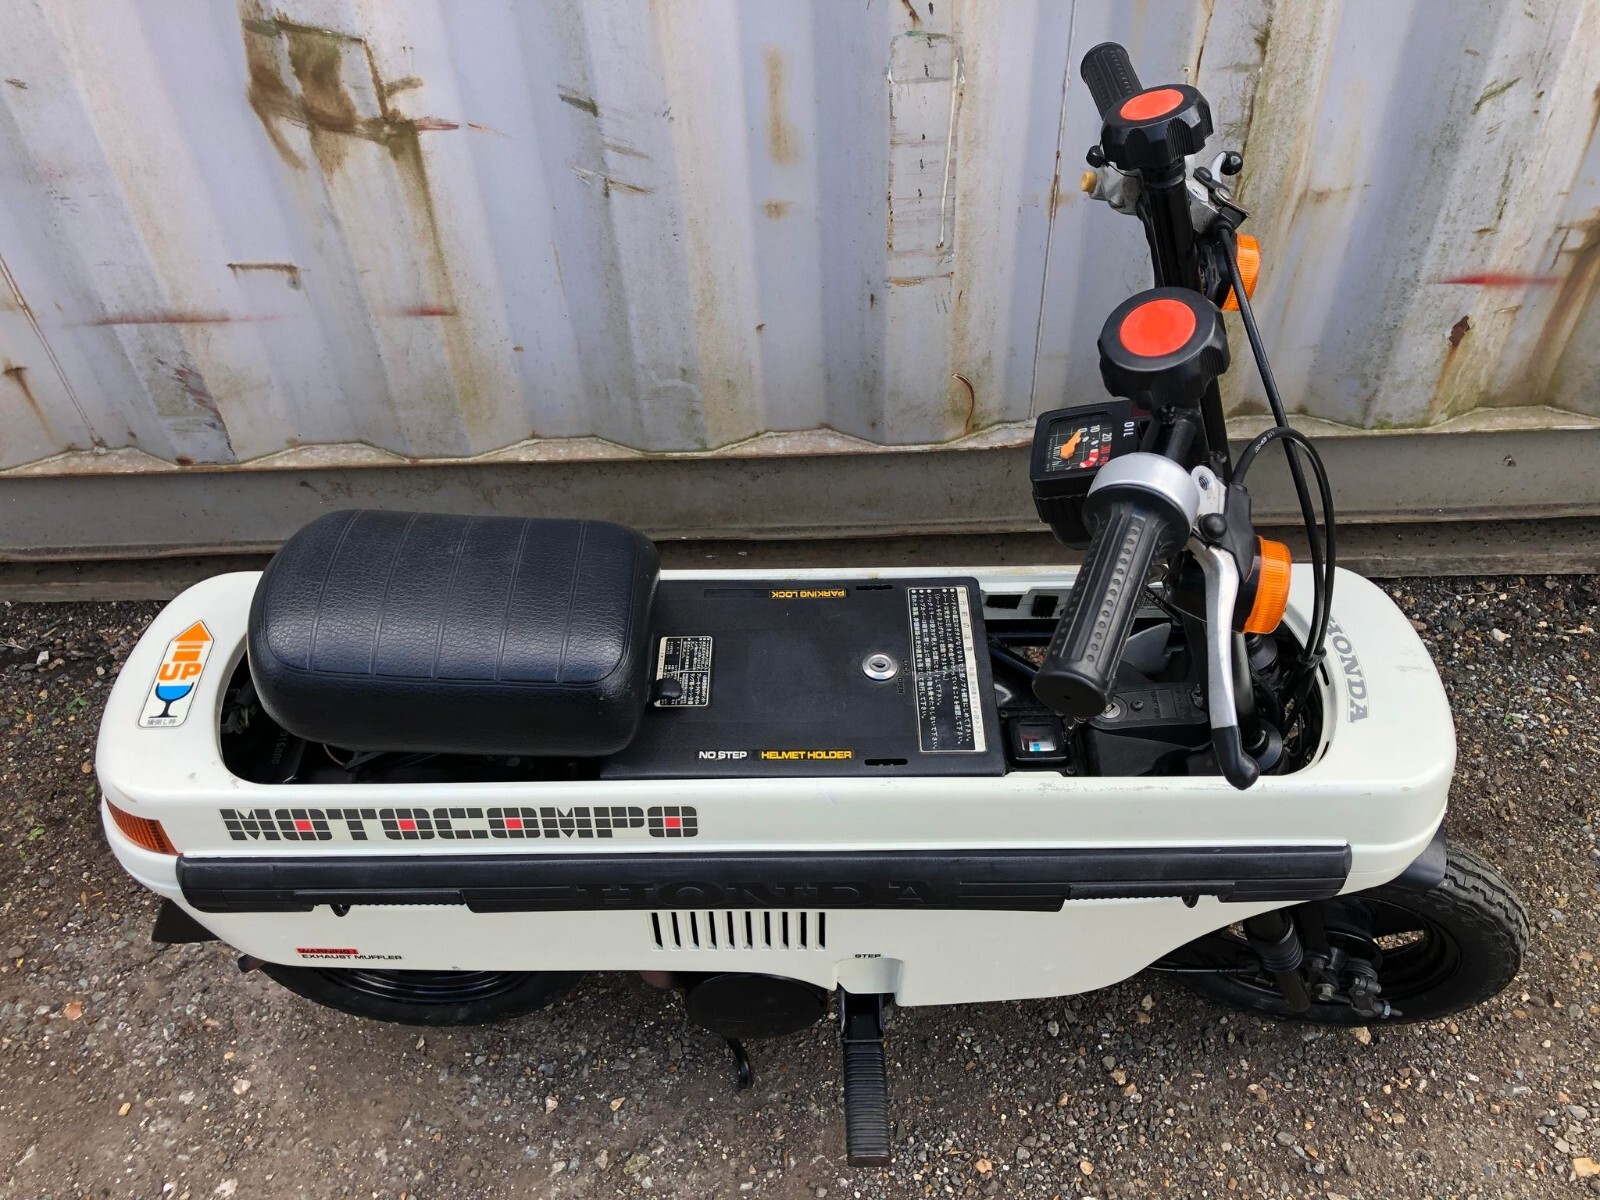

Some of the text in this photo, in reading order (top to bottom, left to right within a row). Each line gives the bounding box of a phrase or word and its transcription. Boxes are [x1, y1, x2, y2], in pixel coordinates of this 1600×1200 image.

[1089, 424, 1101, 433] 10
[1123, 421, 1135, 437] OIL
[1101, 432, 1113, 442] 20
[799, 590, 845, 598] PARKING
[159, 663, 202, 681] UP
[1326, 614, 1368, 724] HONDA
[698, 751, 747, 760] NO STEP
[761, 751, 852, 760] HELMET HOLDER
[220, 806, 698, 841] MOTOCOMPO
[574, 881, 939, 906] HONDA
